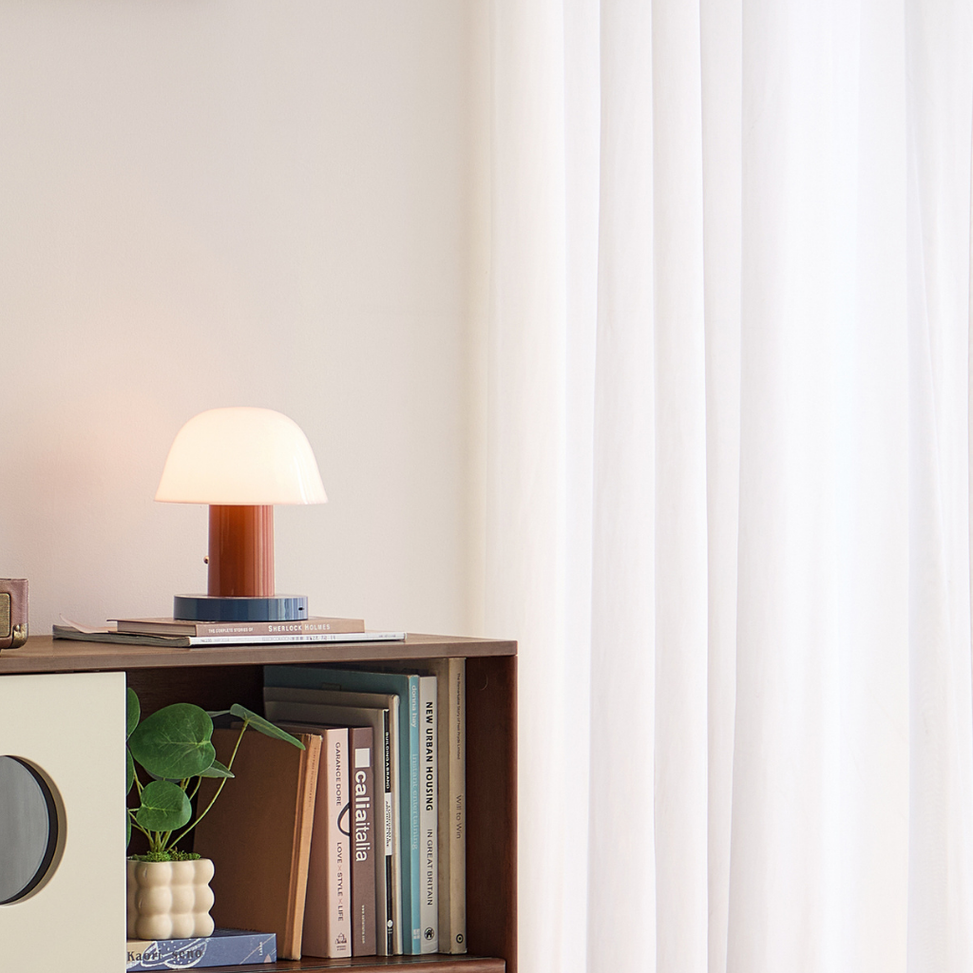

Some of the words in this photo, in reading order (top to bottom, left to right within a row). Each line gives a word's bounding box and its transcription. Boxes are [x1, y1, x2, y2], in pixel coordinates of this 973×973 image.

[268, 625, 302, 633] SHERLOCK
[305, 623, 331, 631] HOLMES
[410, 713, 418, 728] hay
[355, 770, 370, 862] caliaitalia
[456, 812, 462, 821] to
[427, 829, 433, 838] IN
[127, 950, 161, 962] Kaori
